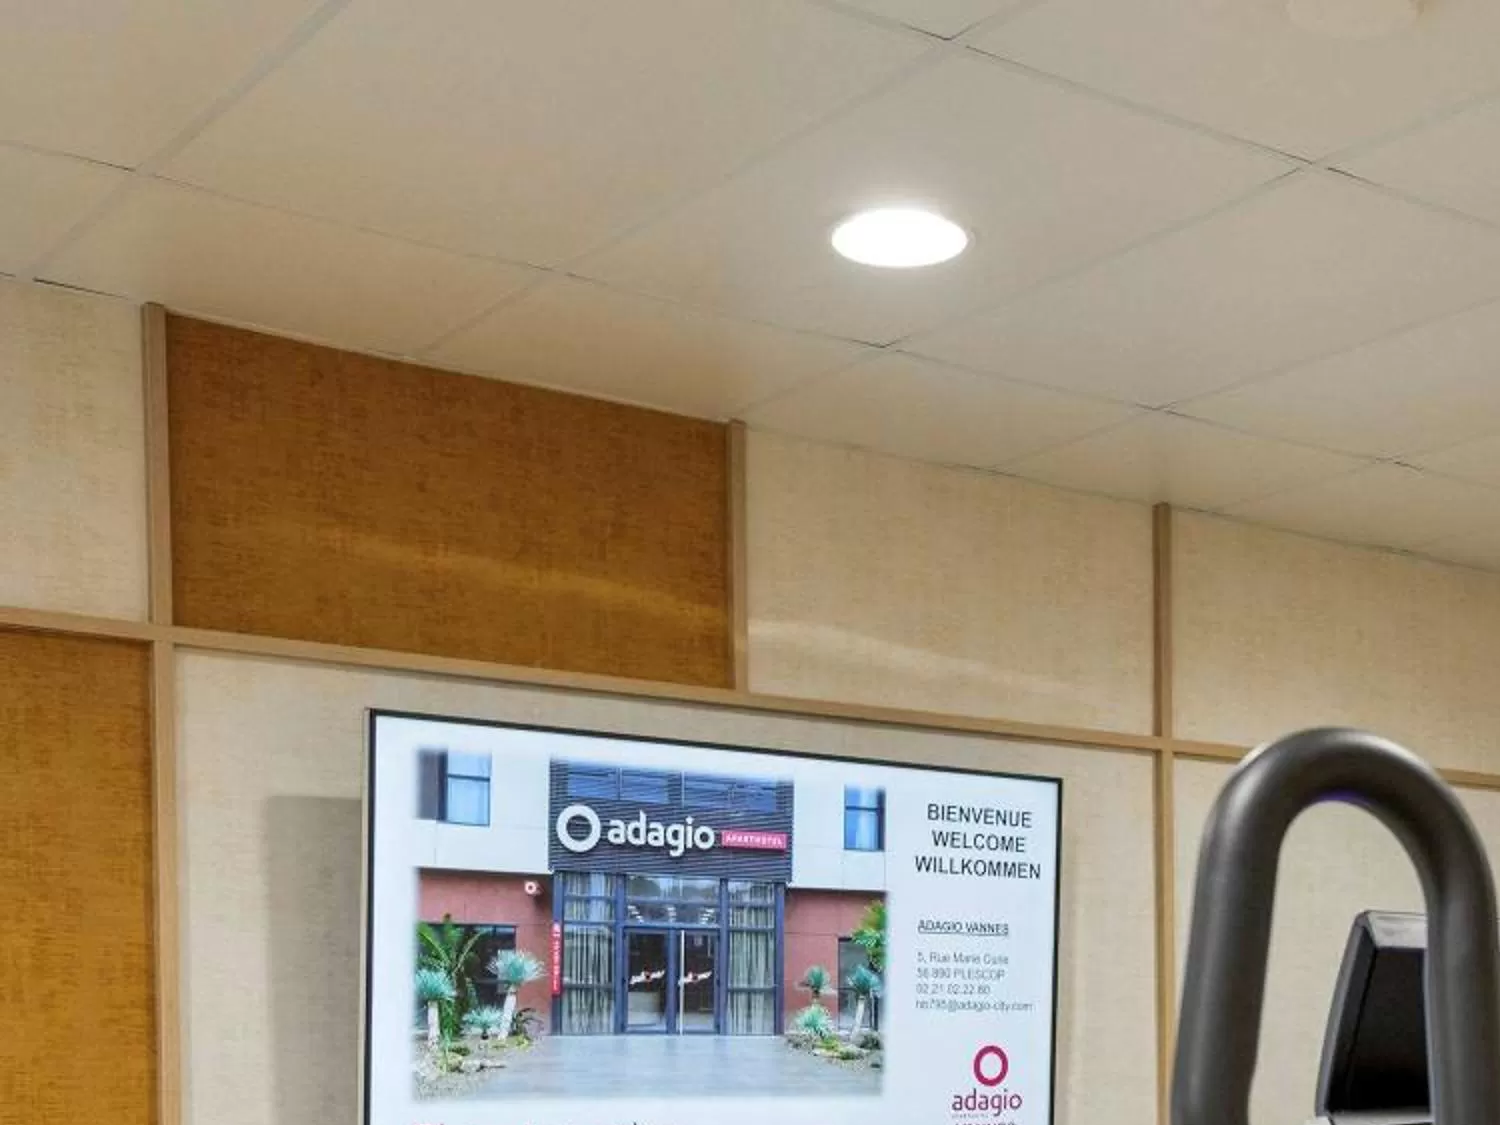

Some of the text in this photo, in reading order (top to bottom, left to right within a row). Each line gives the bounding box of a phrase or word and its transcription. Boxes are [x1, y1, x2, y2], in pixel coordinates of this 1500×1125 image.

[927, 803, 1033, 828] BIENVENUE
[607, 809, 715, 857] adagio
[931, 830, 1026, 853] WELCOME
[915, 856, 1041, 879] WILLKOMMEN
[918, 920, 1009, 935] ADAGIO VANNES
[951, 1088, 1023, 1117] adagio
